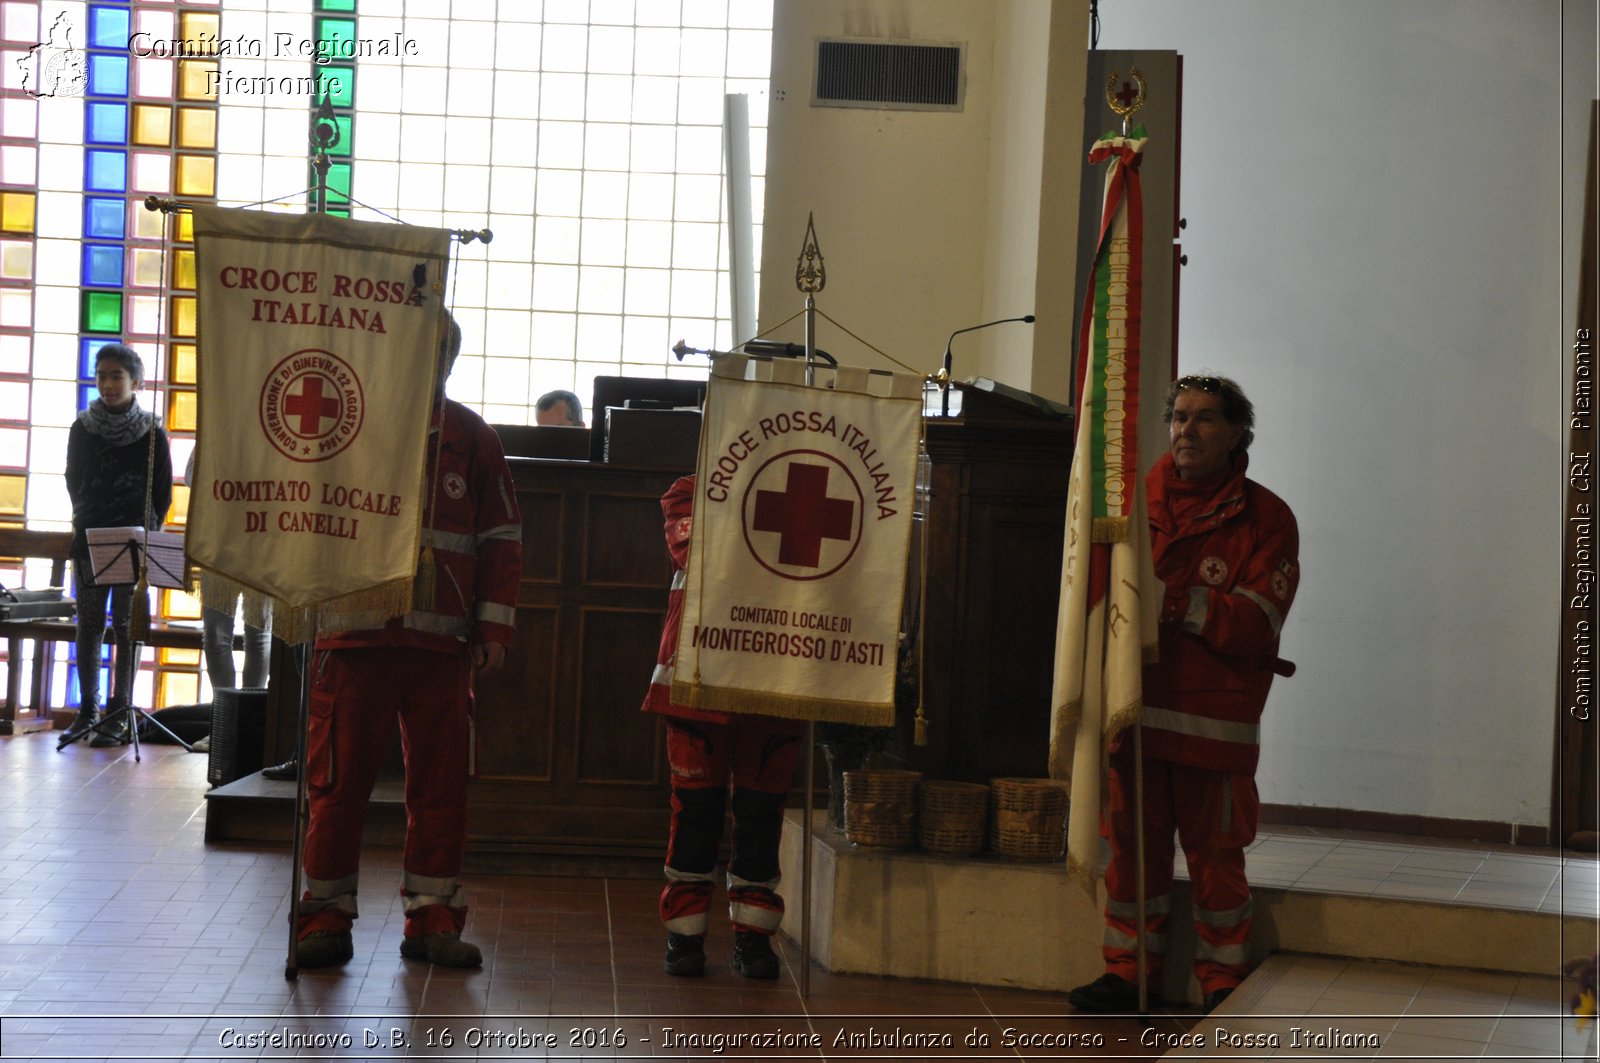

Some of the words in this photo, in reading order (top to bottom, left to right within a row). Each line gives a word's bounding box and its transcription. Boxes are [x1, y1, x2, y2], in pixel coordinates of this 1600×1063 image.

[220, 265, 317, 295] CROCE
[333, 274, 424, 308] ROSSA
[250, 299, 387, 335] ITALIANA
[281, 365, 294, 381] DI
[292, 356, 340, 377] GINEVRA
[336, 373, 352, 387] 22
[266, 377, 298, 452] CONVENZIONE
[340, 389, 358, 436] AGOSTO
[319, 433, 344, 453] 1864
[1104, 408, 1127, 508] COMITATO
[706, 429, 759, 504] CROCE
[760, 410, 838, 441] ROSSA
[839, 423, 898, 522] ITALIANA
[321, 483, 402, 517] LOCALE
[245, 511, 268, 533] DI
[278, 513, 359, 540] CANELLI
[729, 606, 790, 627] COMITATO
[791, 608, 838, 632] LOCALE
[839, 615, 852, 633] DI
[691, 625, 827, 660] MONTEGROSSO
[830, 640, 884, 667] D'ASTI
